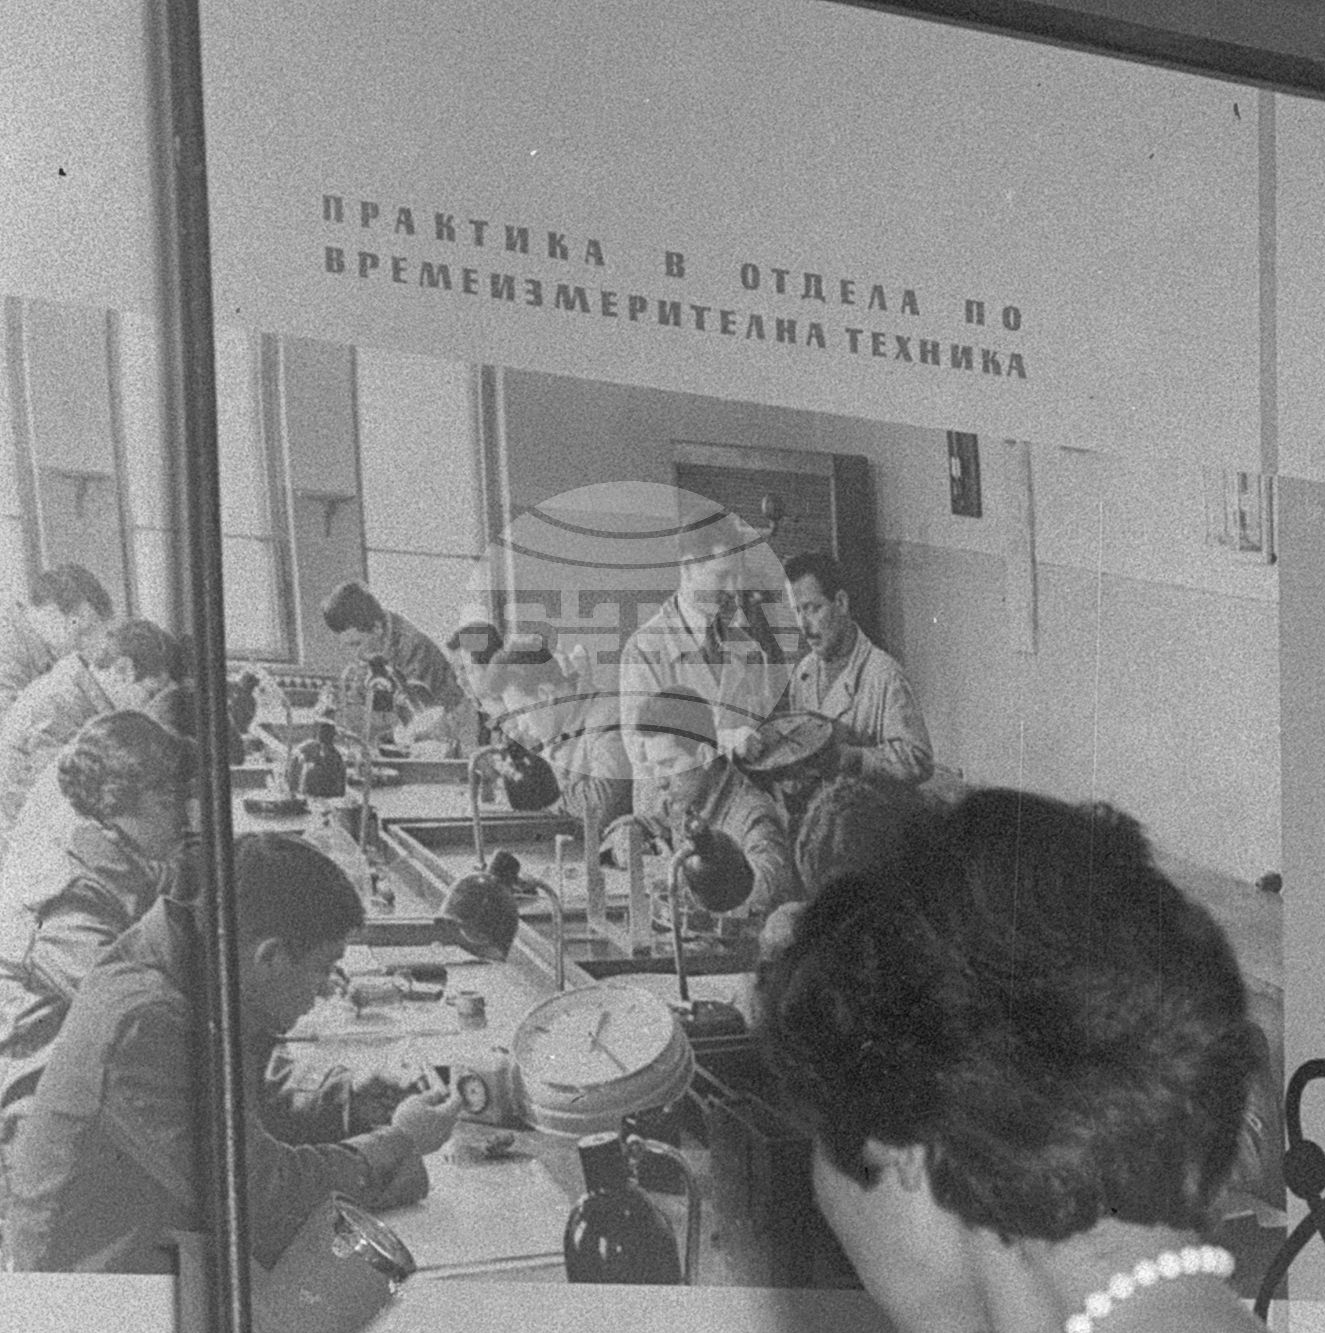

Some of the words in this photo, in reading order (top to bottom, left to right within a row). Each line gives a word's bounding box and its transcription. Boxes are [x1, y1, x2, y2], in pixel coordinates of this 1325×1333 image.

[321, 194, 607, 267] ПРАКТИКА
[663, 249, 687, 280] В
[739, 262, 922, 317] ОТДЕЛА
[964, 299, 1023, 333] ПО
[324, 246, 828, 350] ВРЕМЕИЗМЕРИТЕЛНА
[844, 327, 1029, 380] ТЕХНИКА
